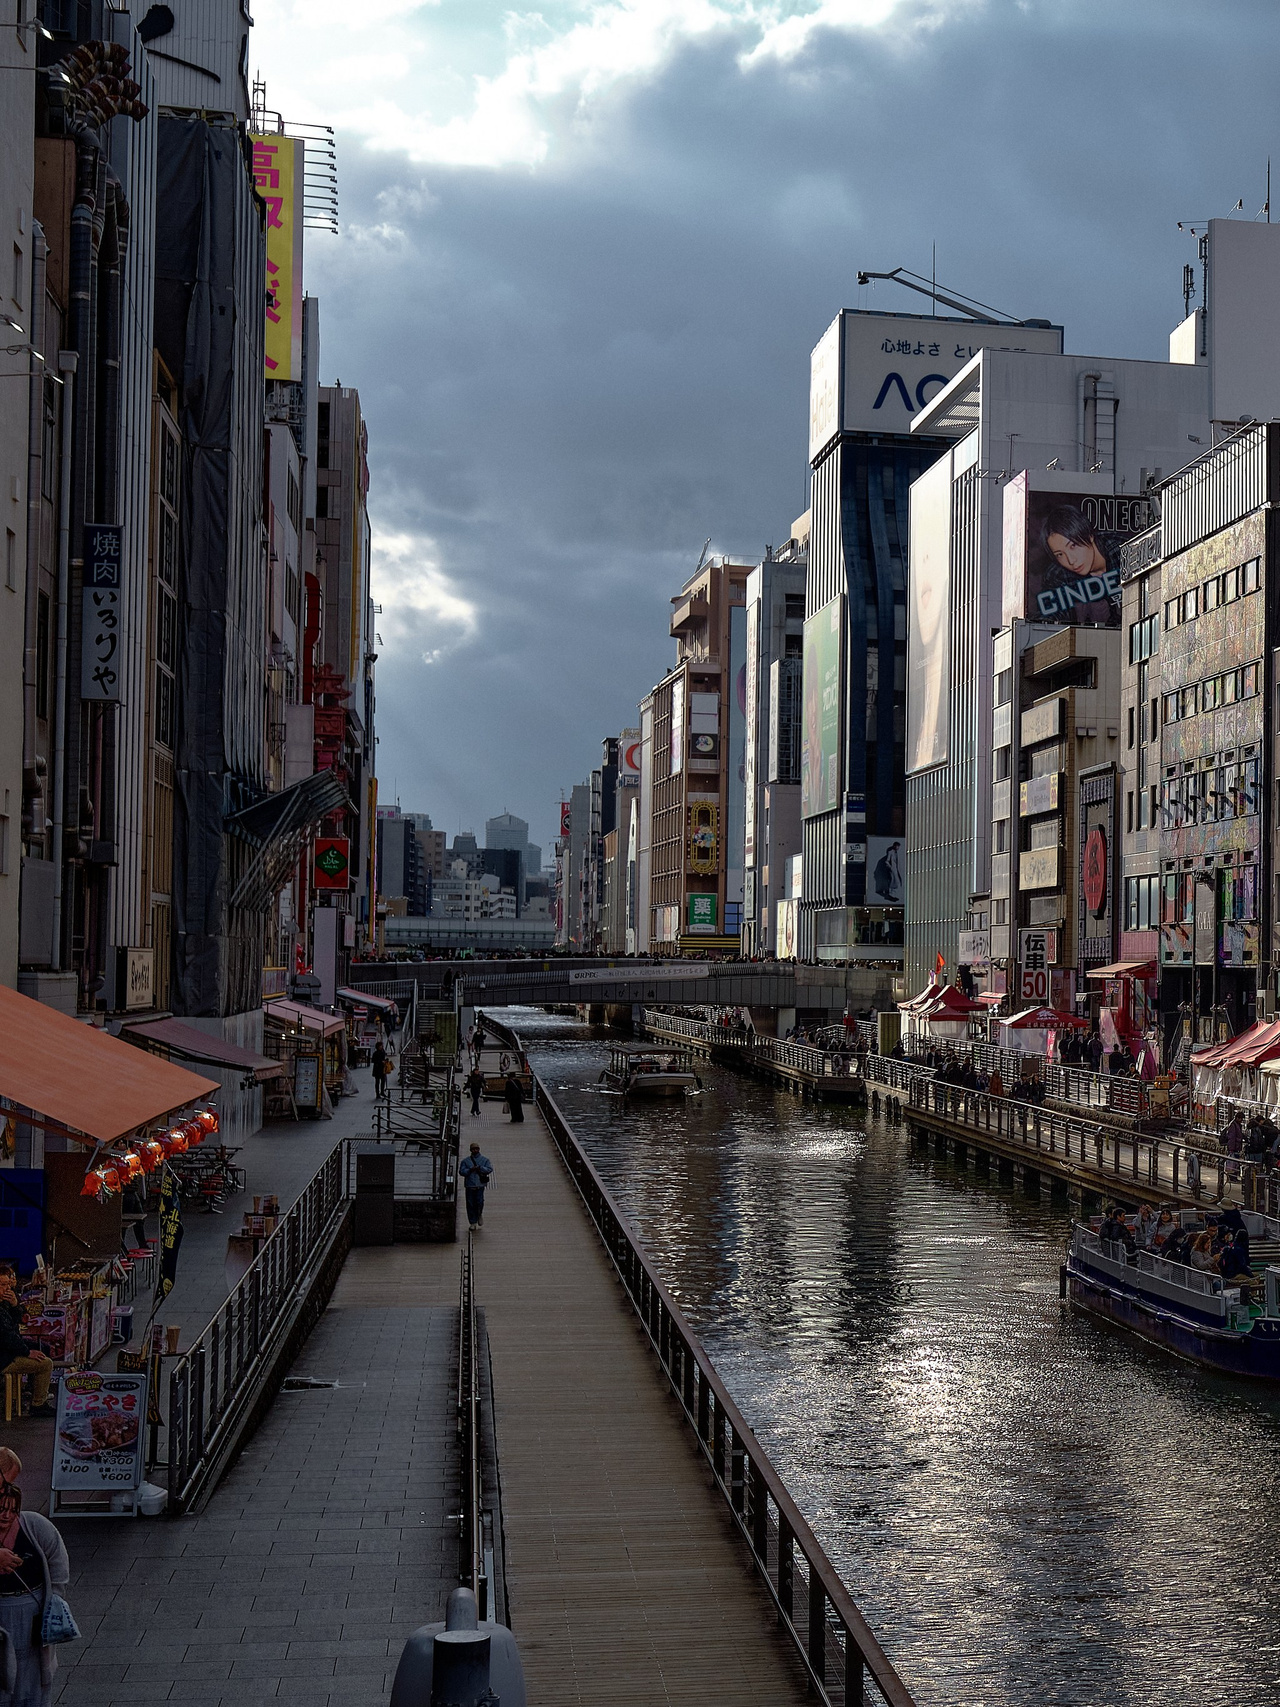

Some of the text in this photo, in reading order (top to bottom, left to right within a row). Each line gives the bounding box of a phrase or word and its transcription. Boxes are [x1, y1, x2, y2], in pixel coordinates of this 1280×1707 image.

[881, 338, 941, 356] 心地よさ
[92, 531, 120, 695] 焼肉 いろりや
[1022, 933, 1047, 998] 伝串 50
[65, 1394, 137, 1411] たこやき
[61, 1465, 90, 1473] ¥100
[101, 1473, 132, 1481] ¥600
